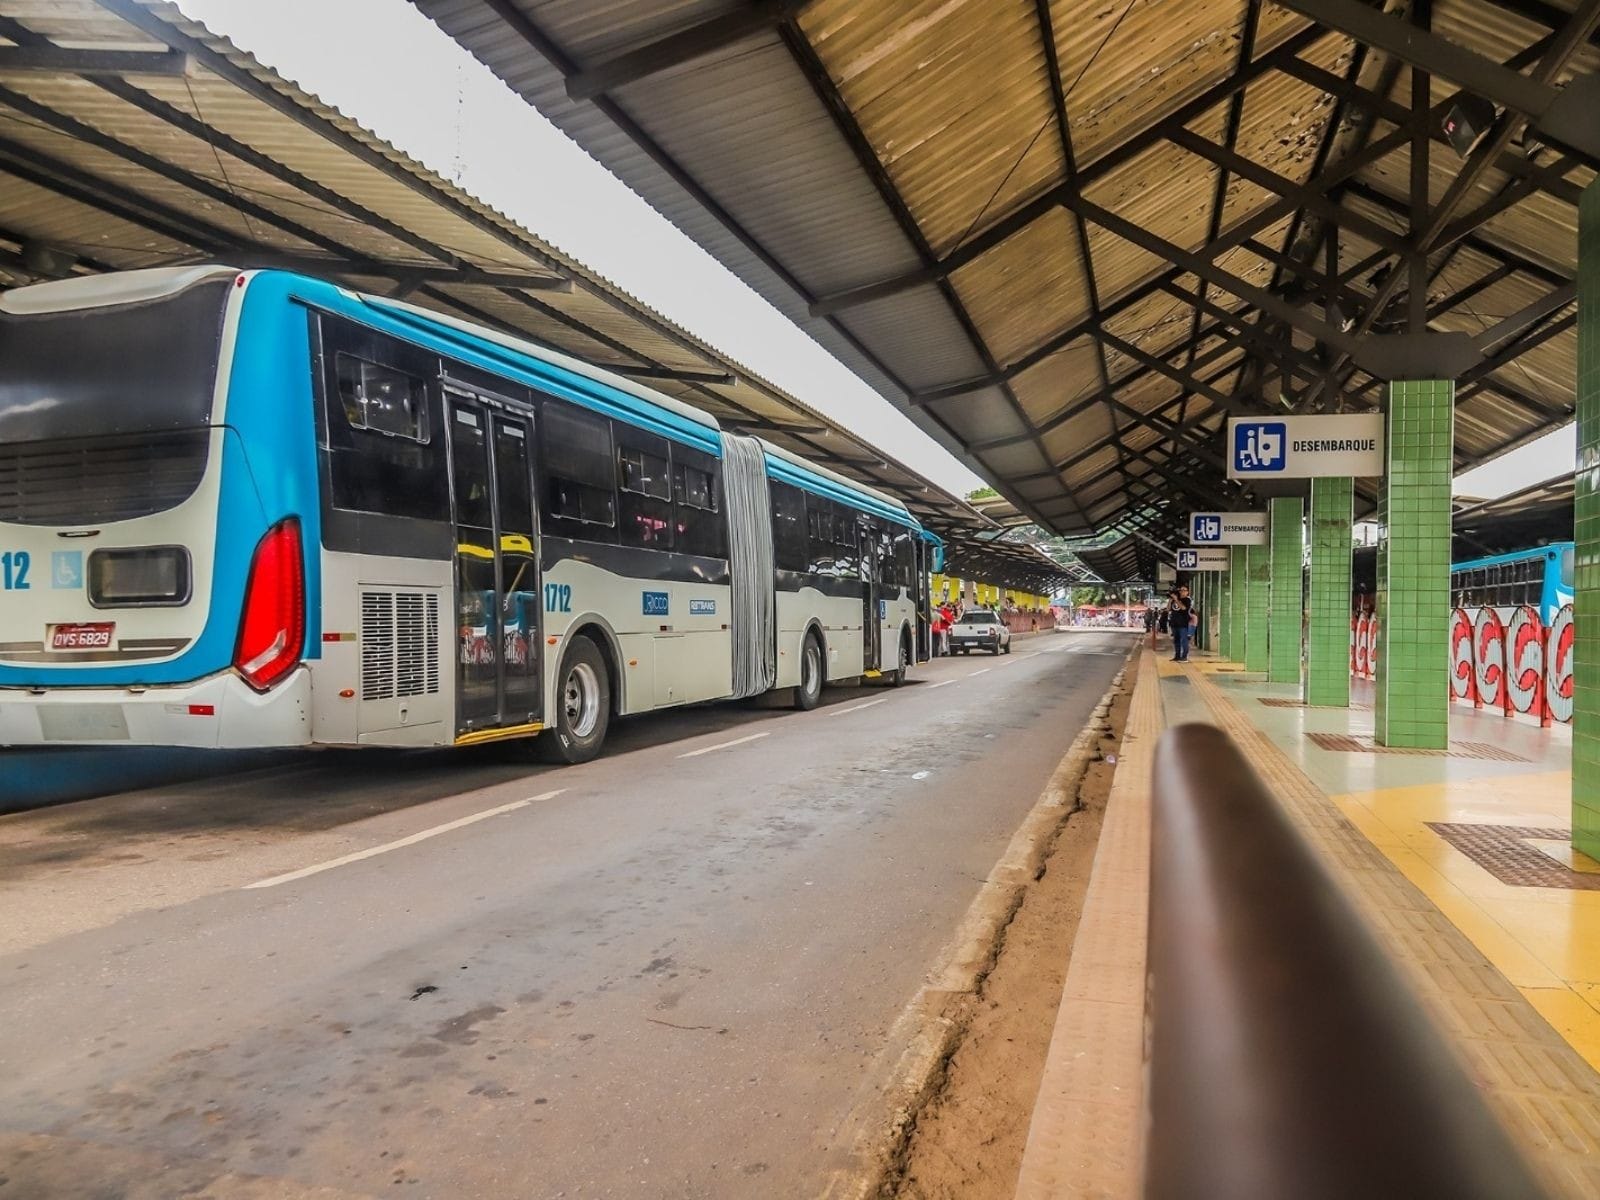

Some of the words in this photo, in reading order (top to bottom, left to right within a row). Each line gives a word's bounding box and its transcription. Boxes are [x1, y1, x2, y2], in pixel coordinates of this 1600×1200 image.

[1293, 439, 1376, 453] DESEMBARQUE
[1, 551, 30, 590] 12
[544, 583, 572, 612] 1712
